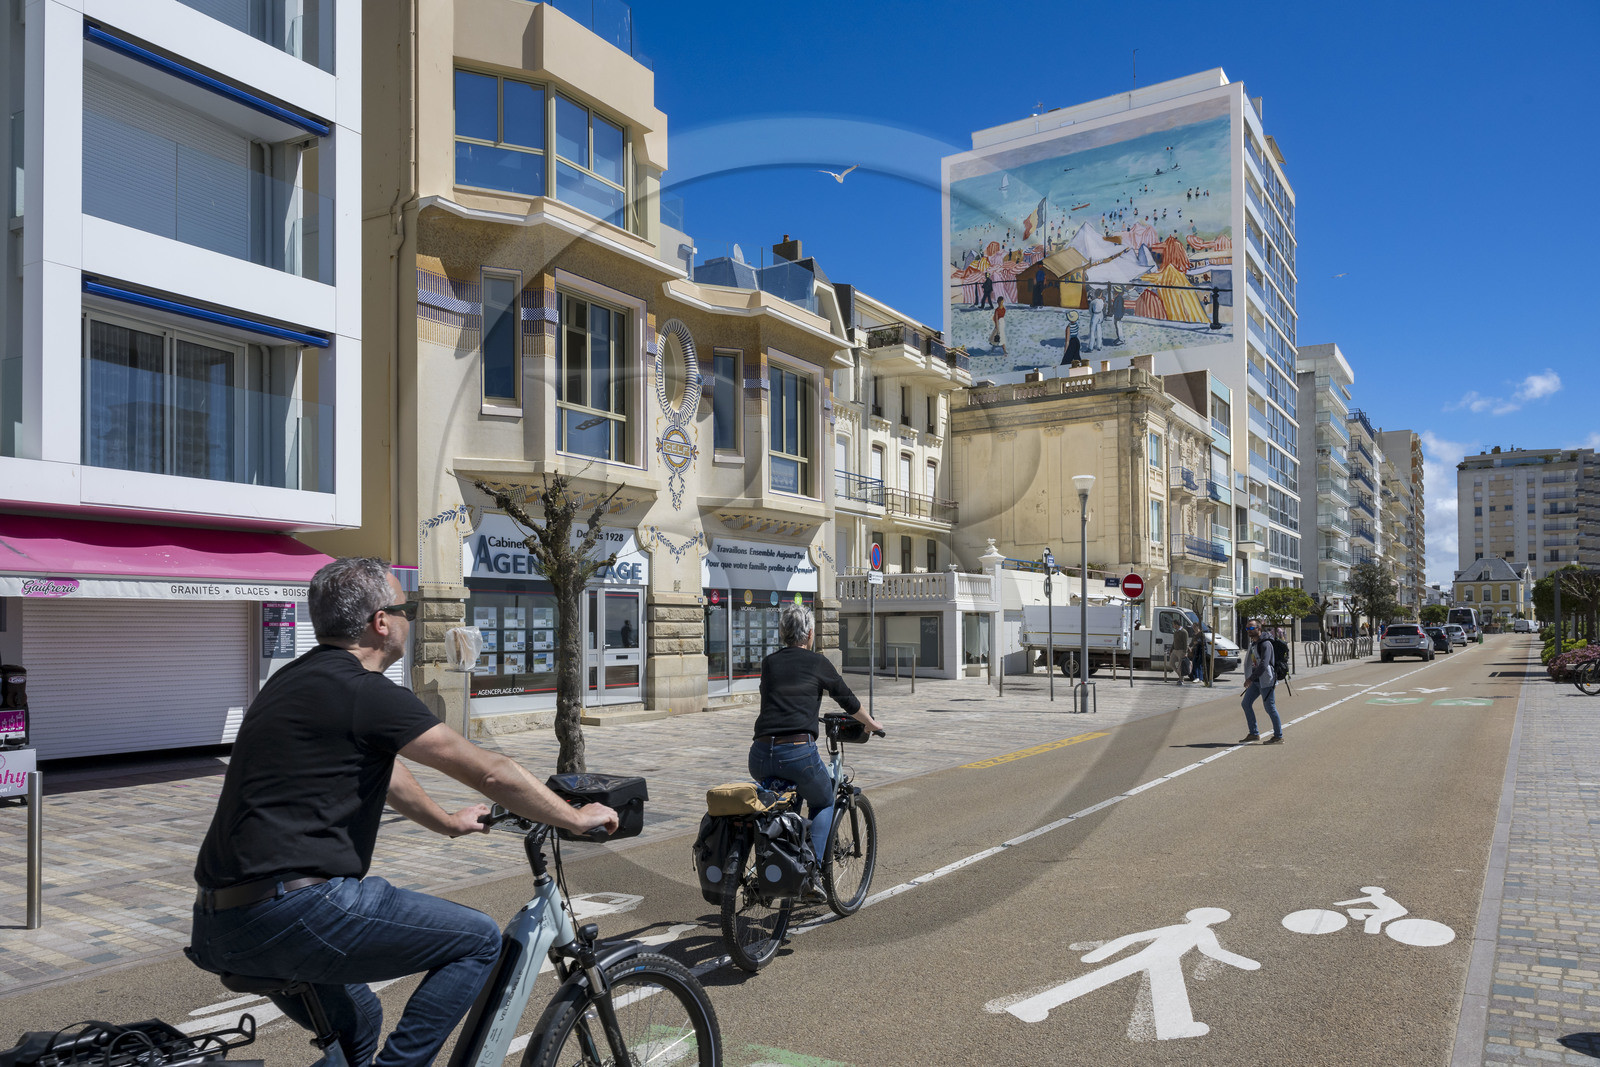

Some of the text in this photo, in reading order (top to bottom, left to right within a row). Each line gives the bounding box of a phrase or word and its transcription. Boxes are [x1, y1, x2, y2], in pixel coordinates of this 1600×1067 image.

[576, 529, 624, 542] Deis 1928
[487, 536, 526, 549] Cabinet
[473, 534, 643, 580] AGEN LAGE
[716, 545, 806, 560] Travaillons Ensemble Aujourd'hui
[705, 559, 719, 568] Pour
[720, 562, 732, 570] que
[733, 562, 748, 570] votre
[748, 562, 767, 571] famille
[767, 565, 786, 573] profite
[22, 579, 77, 595] Gaufrerie
[170, 584, 220, 595] GRANITÉS
[235, 586, 270, 596] GLACES
[477, 687, 525, 696] AGENCEPLAGE.COM
